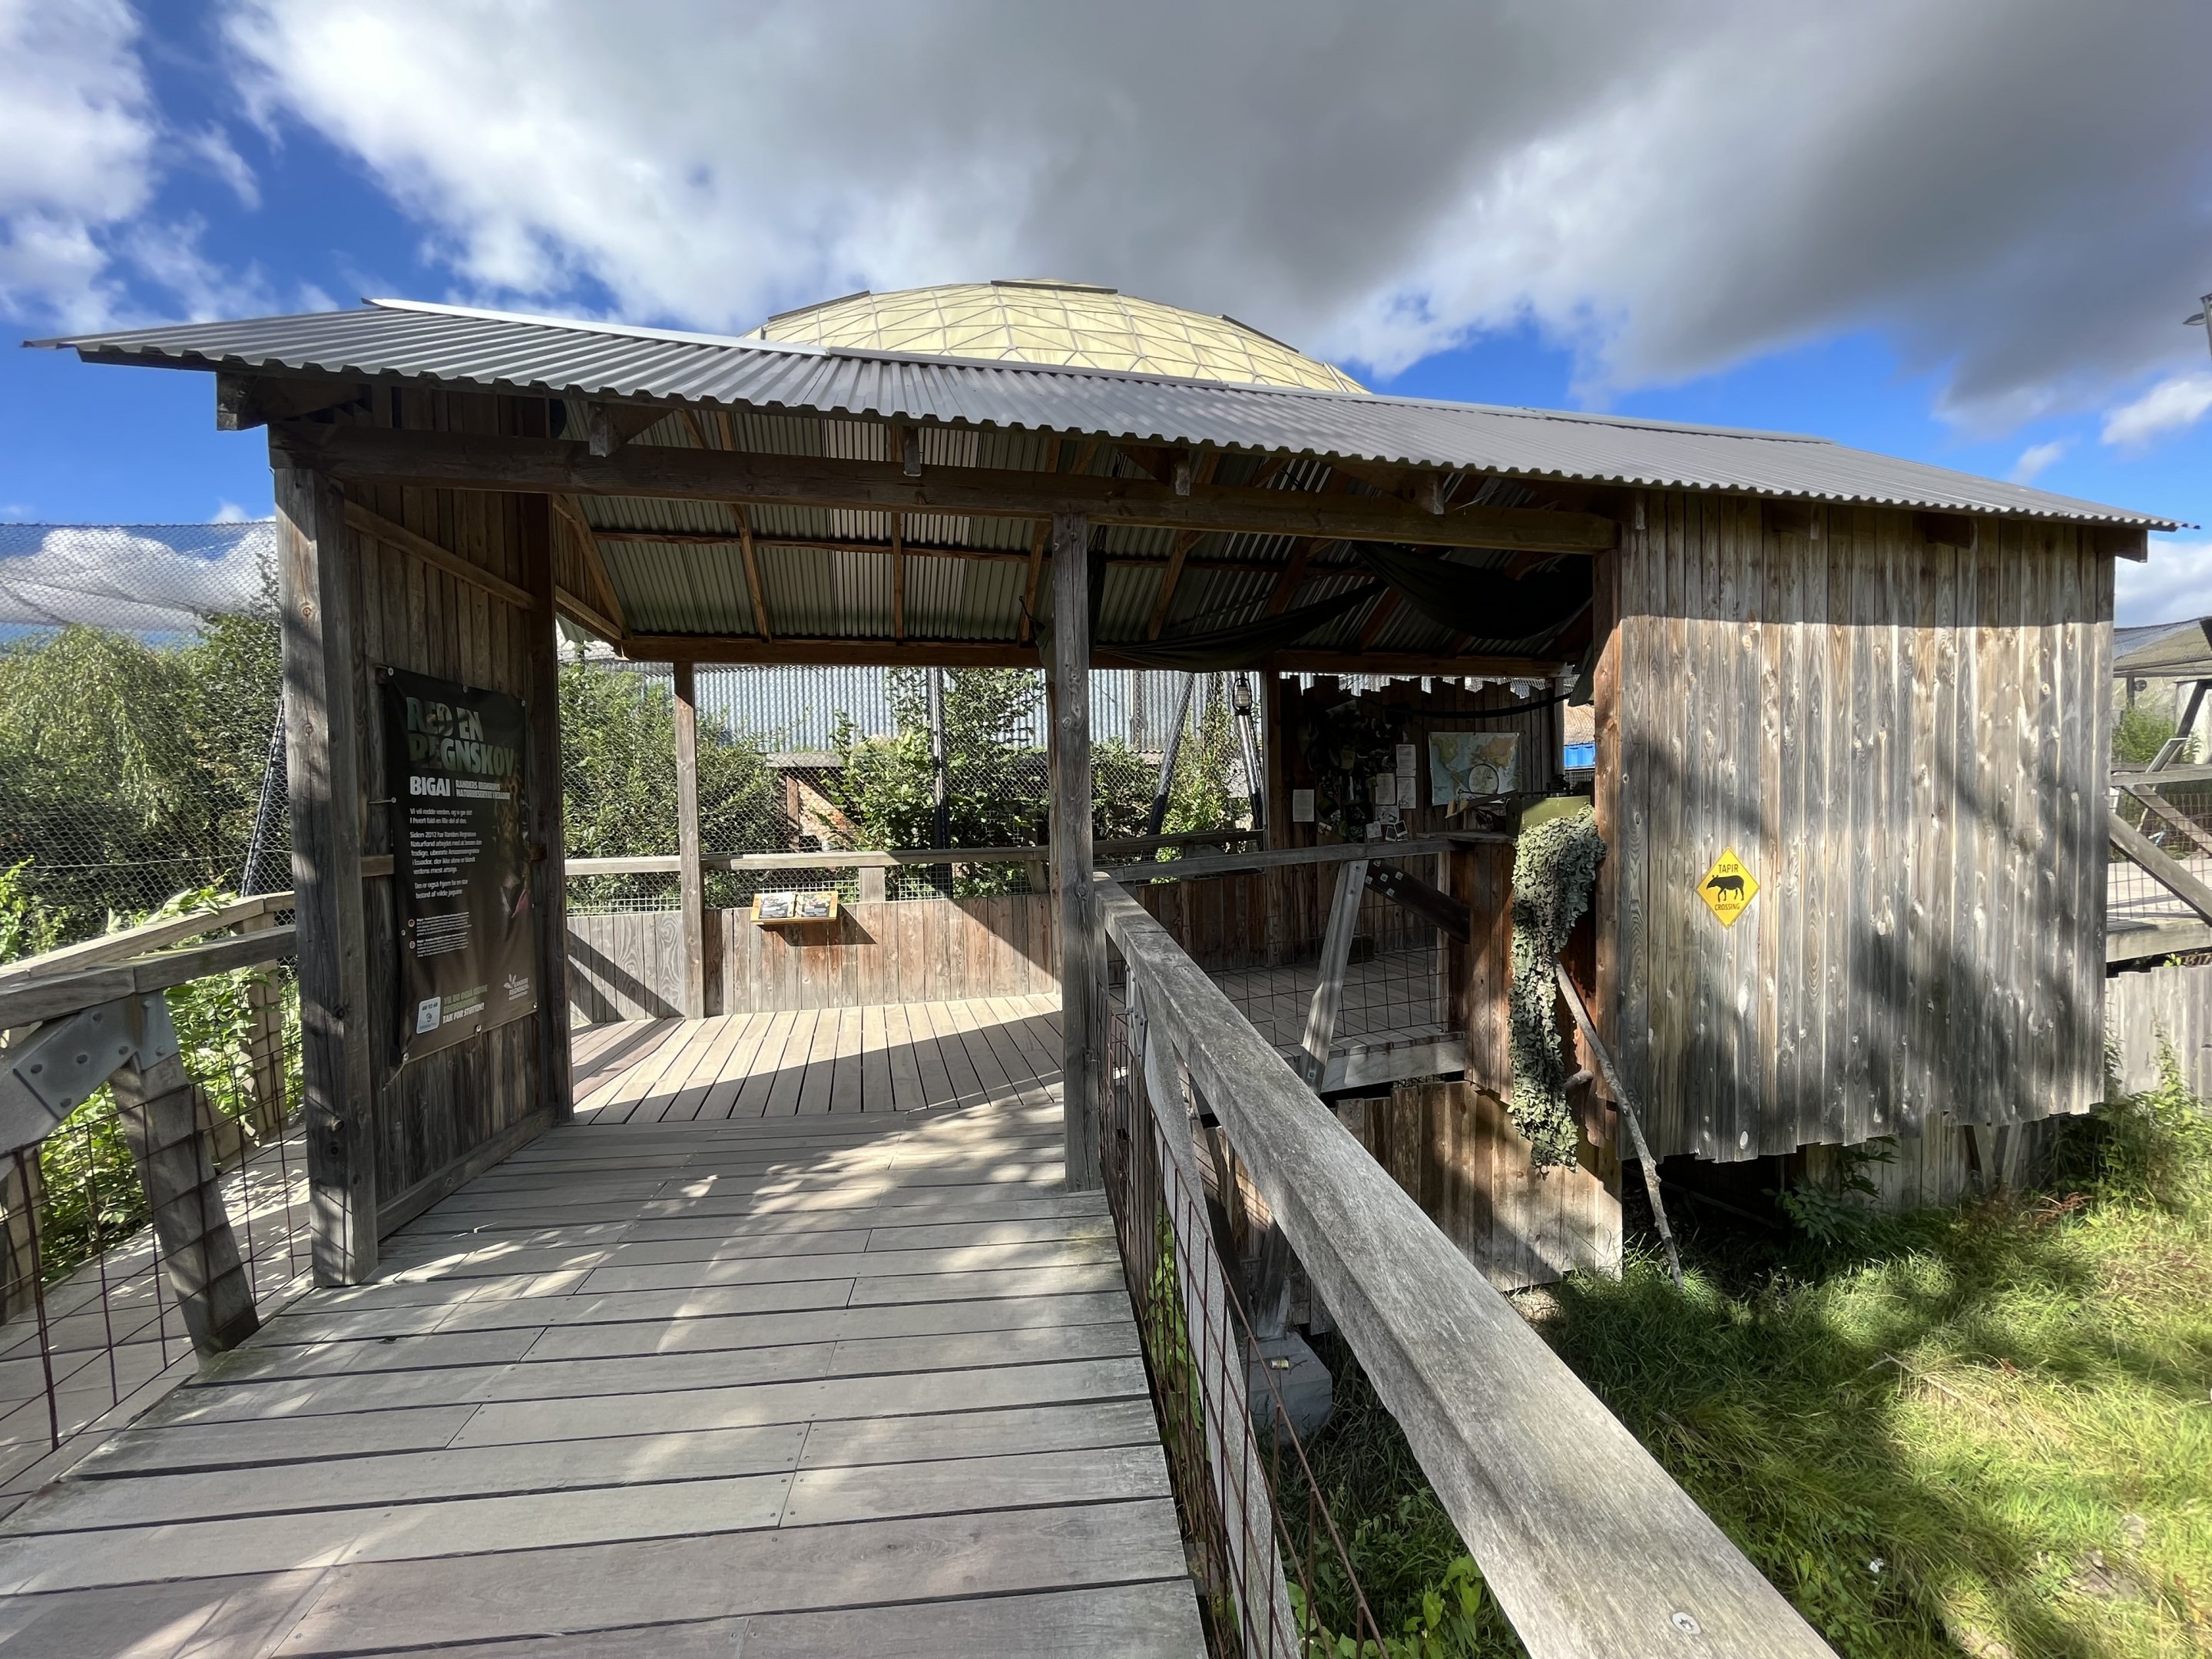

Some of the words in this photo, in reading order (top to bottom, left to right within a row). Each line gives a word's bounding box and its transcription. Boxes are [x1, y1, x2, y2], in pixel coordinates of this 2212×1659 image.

[406, 697, 453, 737] RED
[456, 707, 484, 741] EN
[408, 733, 515, 777] REGNSKOV
[409, 776, 451, 796] BIGAI
[1718, 864, 1739, 873] TAPIR
